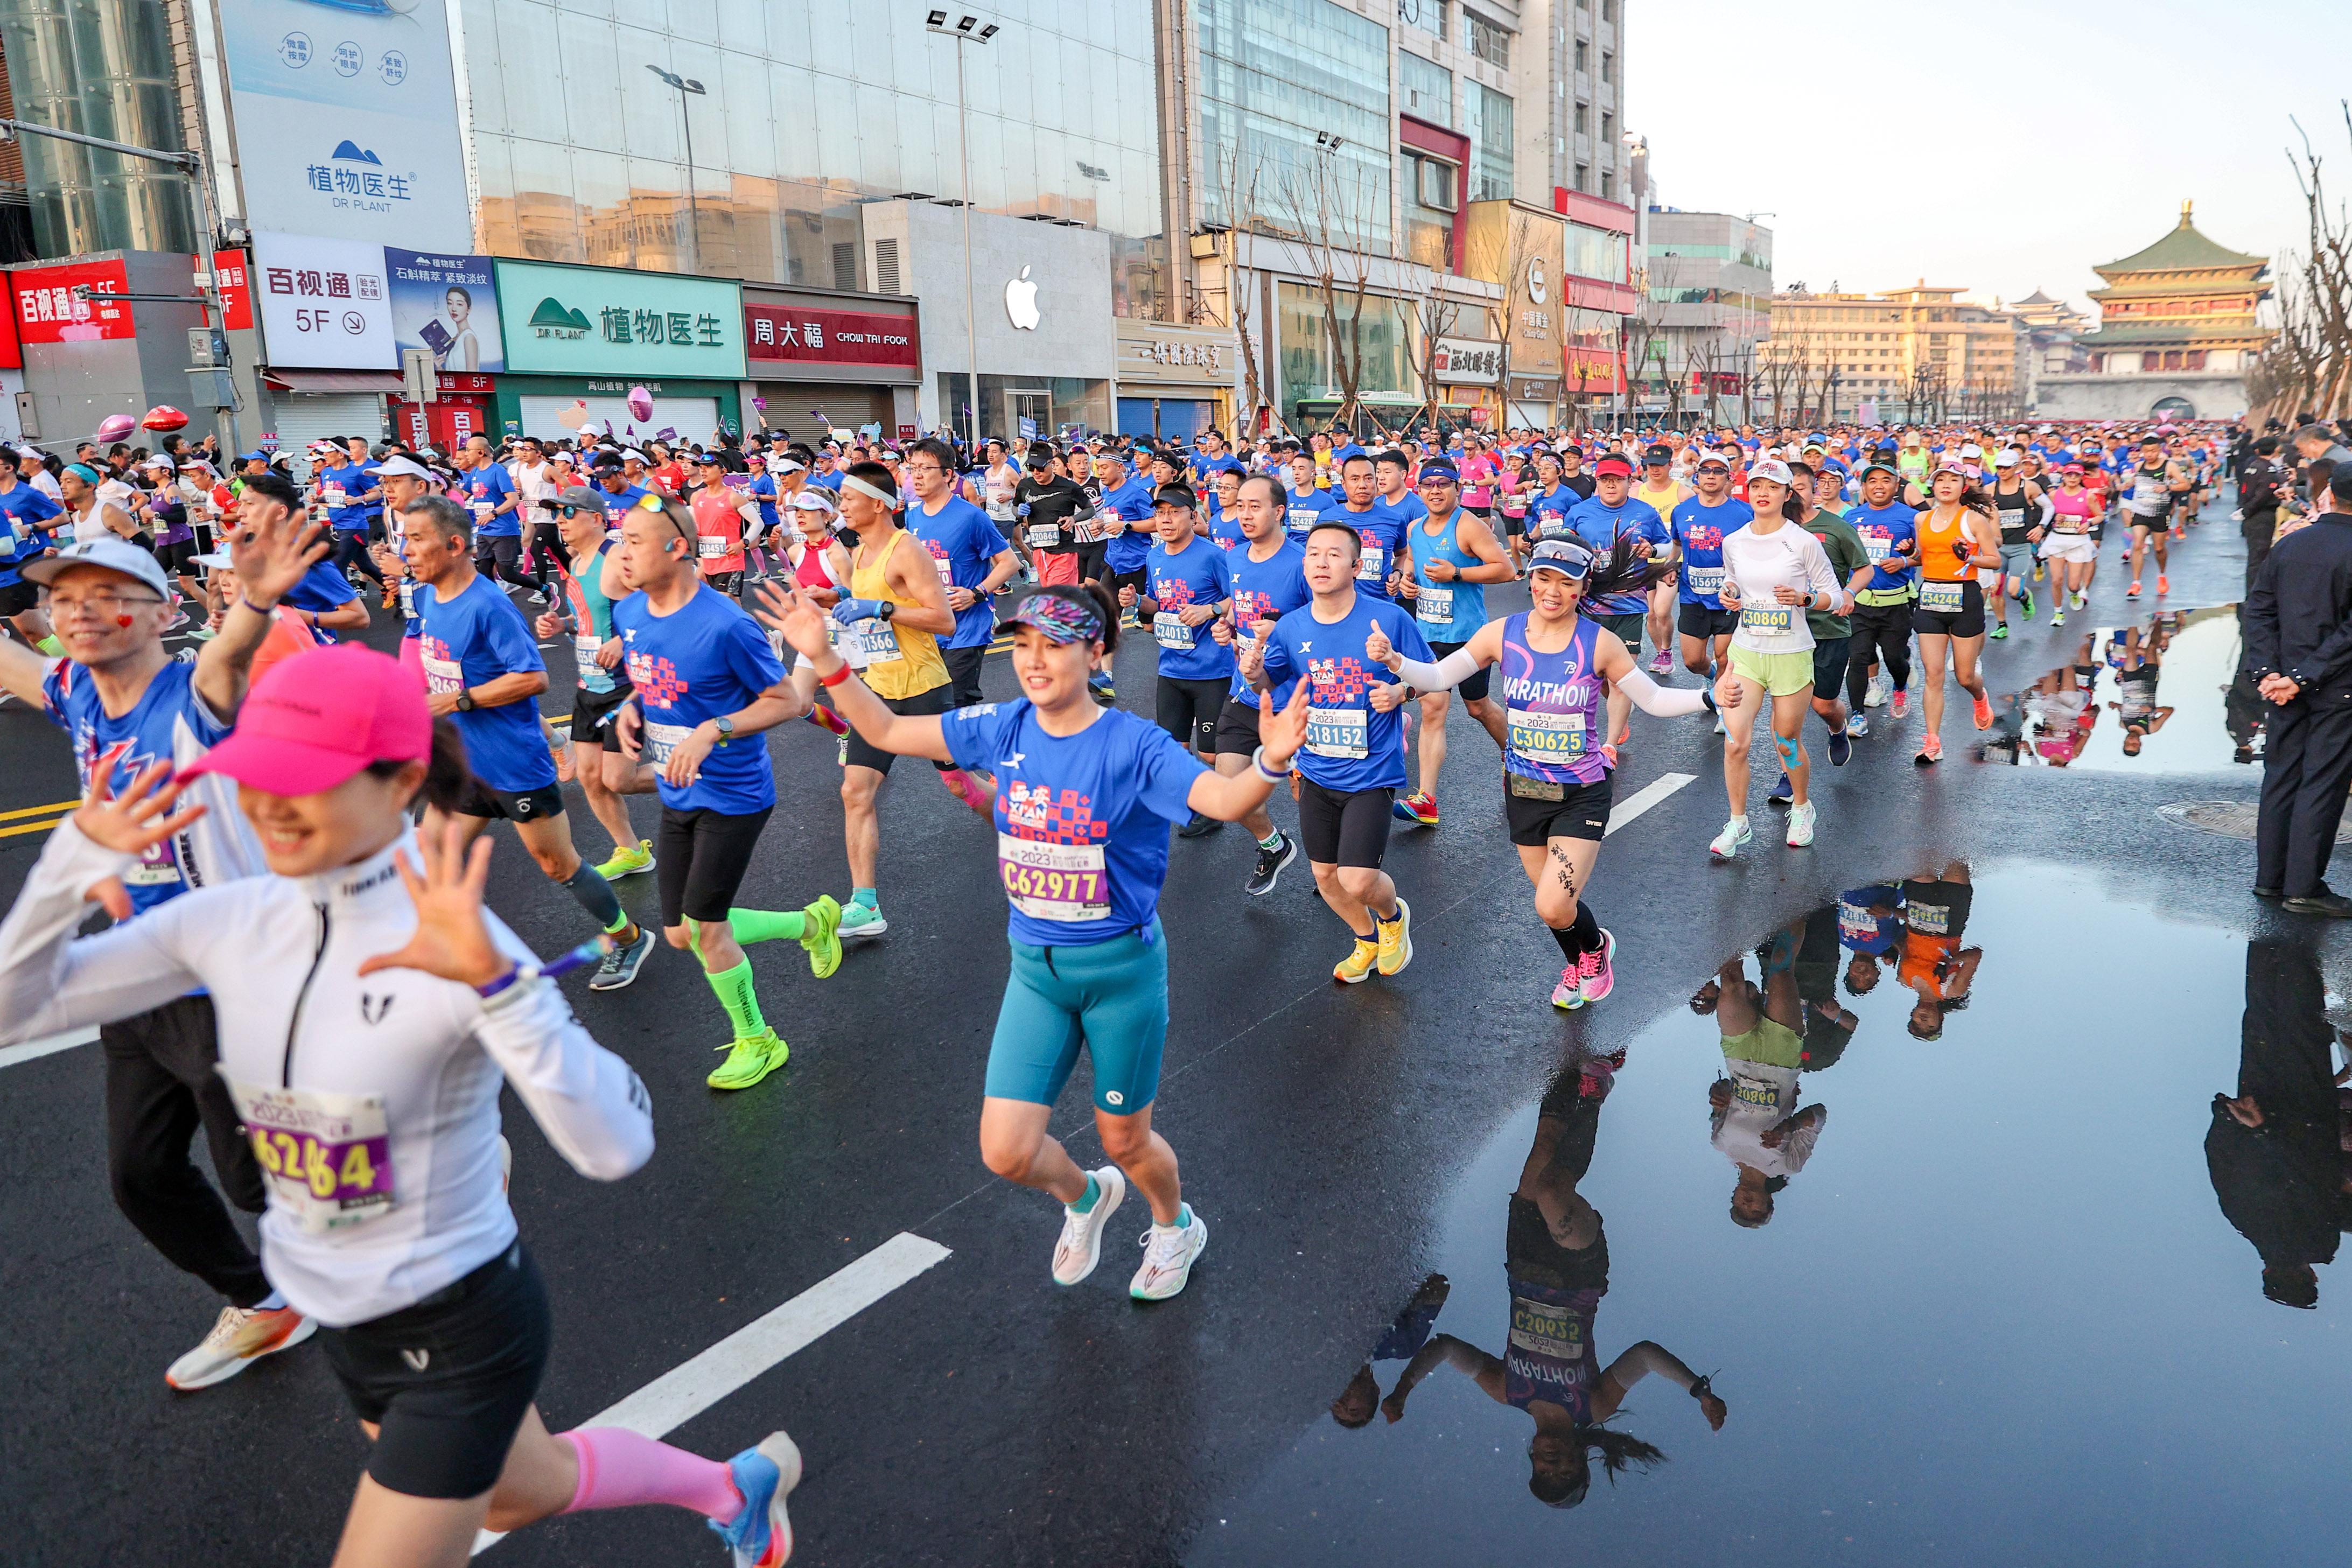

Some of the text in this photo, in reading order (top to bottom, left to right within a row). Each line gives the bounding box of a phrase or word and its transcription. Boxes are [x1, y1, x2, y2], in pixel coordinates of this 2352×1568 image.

[286, 39, 307, 51] 微震
[288, 50, 307, 61] 按摩
[339, 48, 358, 59] 呵护
[340, 59, 358, 71] 眼周
[384, 57, 403, 68] 紧致
[386, 68, 403, 79] 舒纹
[306, 164, 411, 200] 植物医生
[332, 197, 392, 213] DR PLANT
[432, 258, 464, 269] 植物医生
[395, 267, 487, 285] 石斛精萃 紧致淡纹
[267, 267, 352, 299] 百视通
[360, 278, 377, 288] 验光
[97, 280, 116, 307] 5F
[361, 287, 379, 297] 配镜
[19, 286, 72, 323] 百视通
[296, 309, 330, 332] 5F
[1522, 309, 1549, 328] 中国黄金
[599, 305, 724, 347] 植物医生
[536, 327, 586, 340] DR PLANT
[754, 319, 908, 348] 周大福 CHOW TAI FOOK
[1524, 328, 1535, 339] China
[472, 377, 487, 388] 5F
[588, 381, 624, 391] 高山植物
[1290, 517, 1318, 526] C24287
[1030, 531, 1058, 542] B20864
[699, 543, 725, 553] C18451
[1689, 576, 1724, 588] C15699
[1235, 591, 1254, 601] 西安
[1921, 592, 1961, 605] C34244
[1235, 599, 1254, 608] XI'AN
[1417, 597, 1450, 614] C13545
[1750, 601, 1764, 611] 2023
[1743, 610, 1788, 626] C30860
[1156, 625, 1189, 640] C24013
[862, 633, 894, 653] 21366
[1311, 660, 1335, 673] 西安
[1311, 670, 1335, 680] XI'AN
[1503, 675, 1590, 708] MARATHON
[1315, 716, 1334, 725] 2023
[1527, 718, 1549, 729] 2023
[1306, 726, 1363, 746] C18152
[1513, 727, 1582, 751] C30625
[1011, 785, 1050, 804] 西安
[1009, 800, 1048, 822] XI'AN
[1022, 850, 1051, 866] 2023
[1004, 862, 1098, 900] C62977
